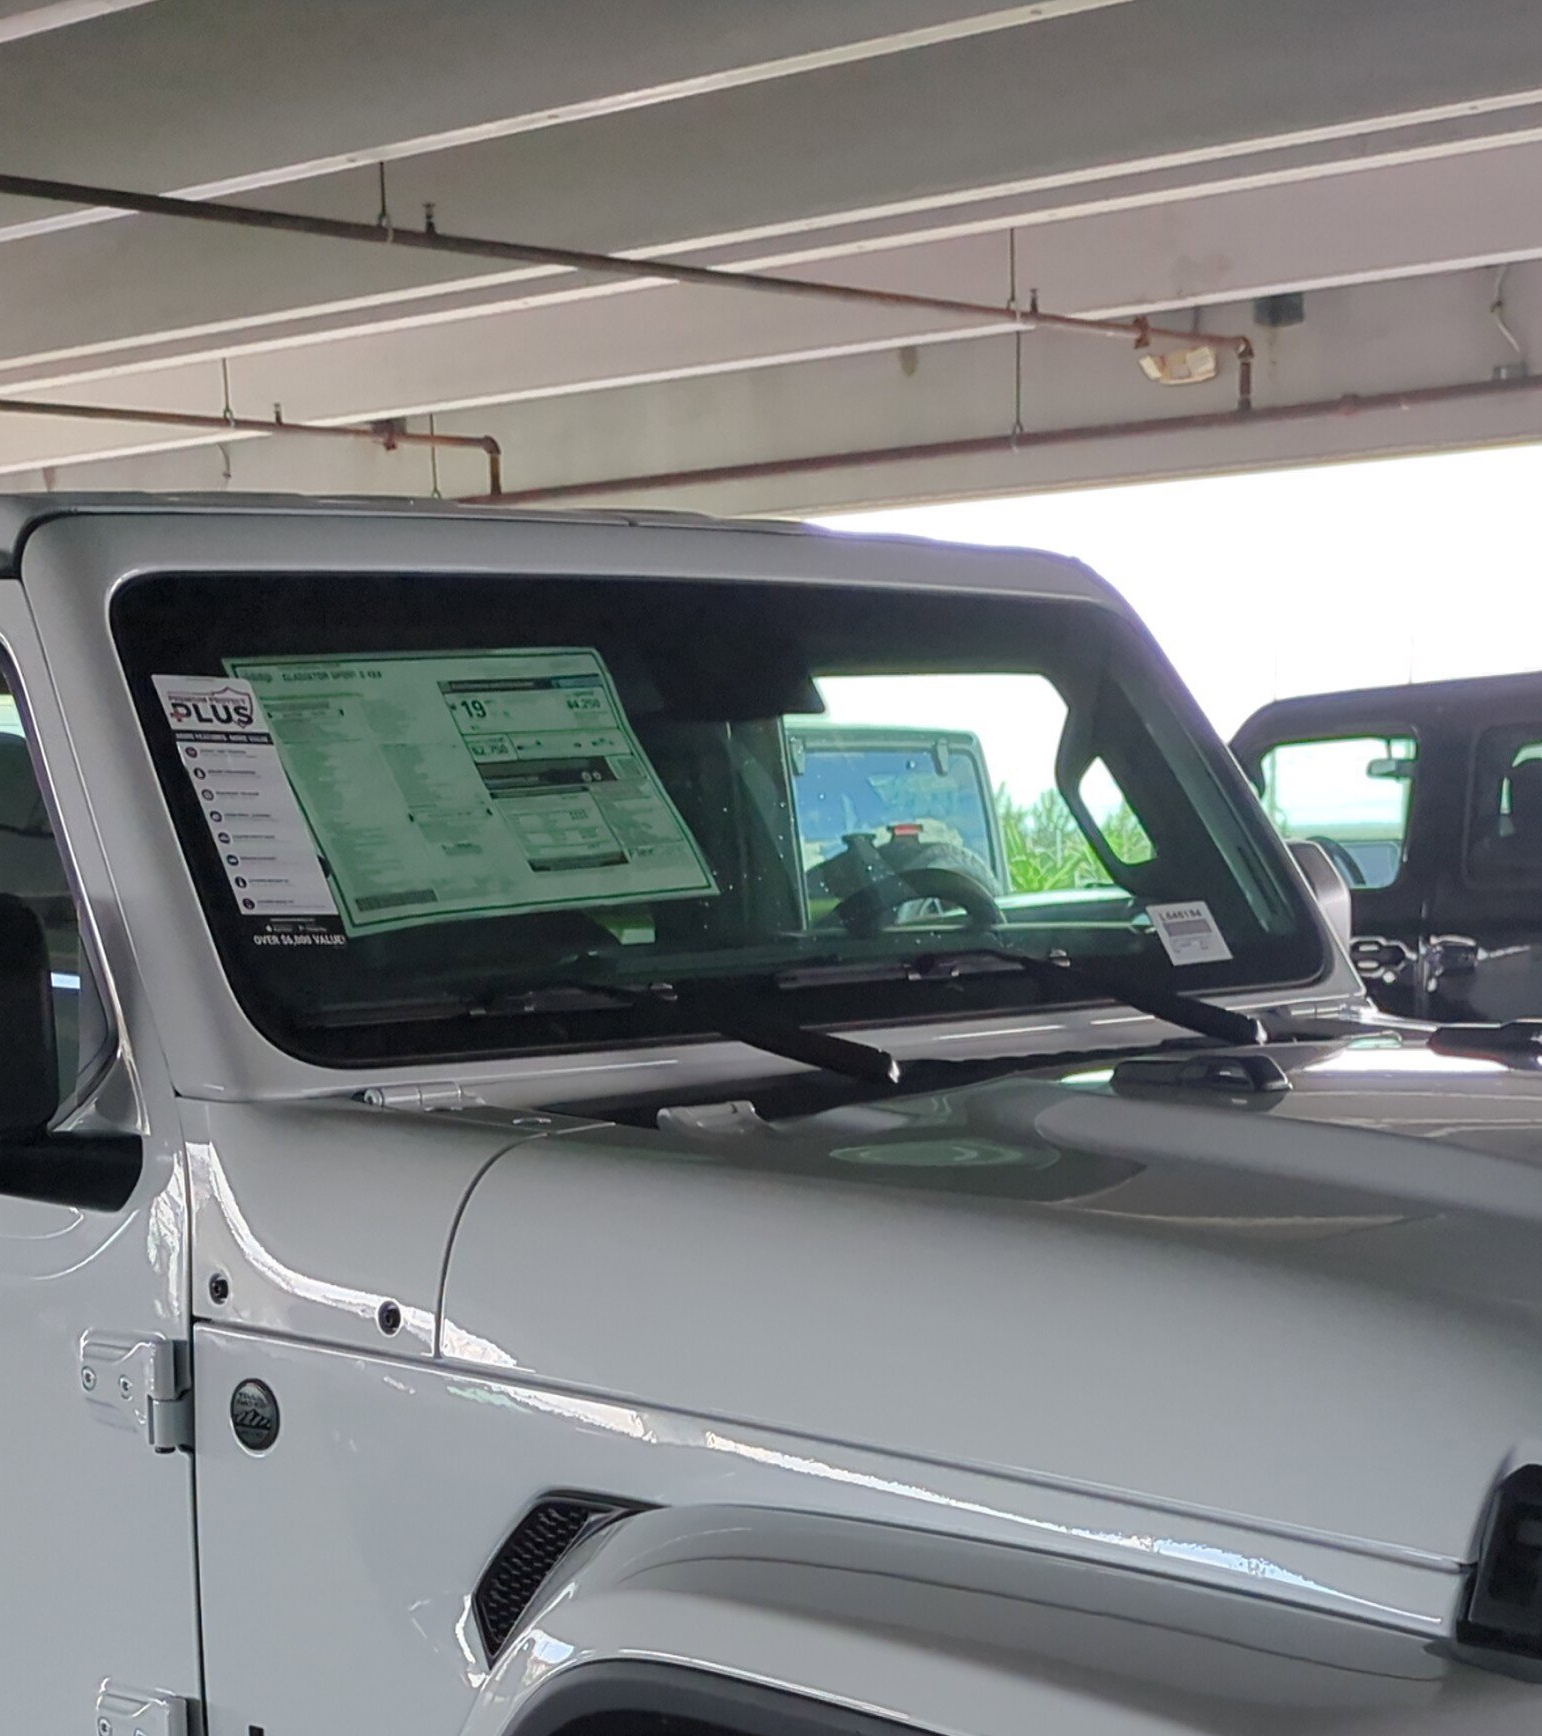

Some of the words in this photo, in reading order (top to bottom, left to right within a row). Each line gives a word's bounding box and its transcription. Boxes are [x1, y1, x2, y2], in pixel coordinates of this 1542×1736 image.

[170, 702, 254, 725] PLUS
[461, 700, 487, 719] 19
[253, 934, 280, 945] OVER
